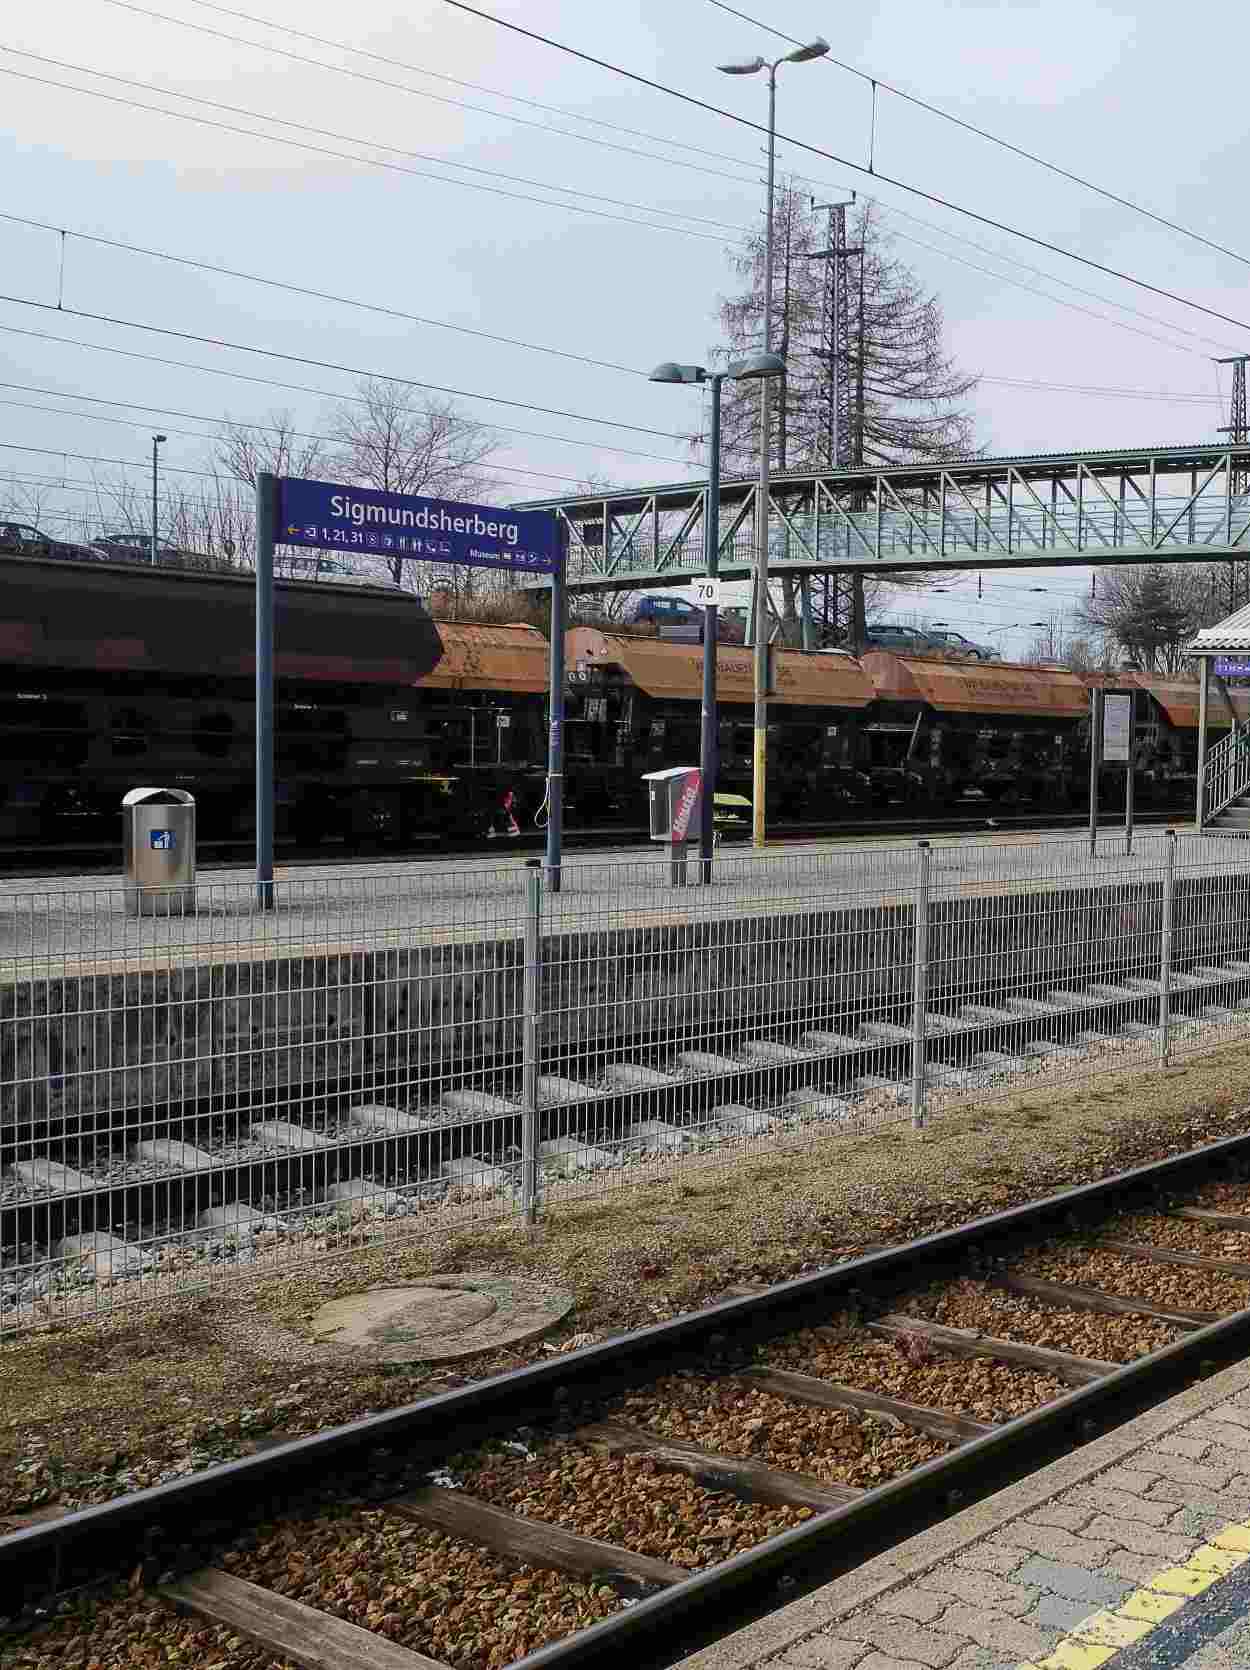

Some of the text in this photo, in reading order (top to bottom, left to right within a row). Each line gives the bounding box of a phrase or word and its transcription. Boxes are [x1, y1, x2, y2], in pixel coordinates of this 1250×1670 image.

[330, 495, 519, 545] Sigmundsherberg
[351, 531, 363, 544] 31
[698, 584, 714, 599] 70
